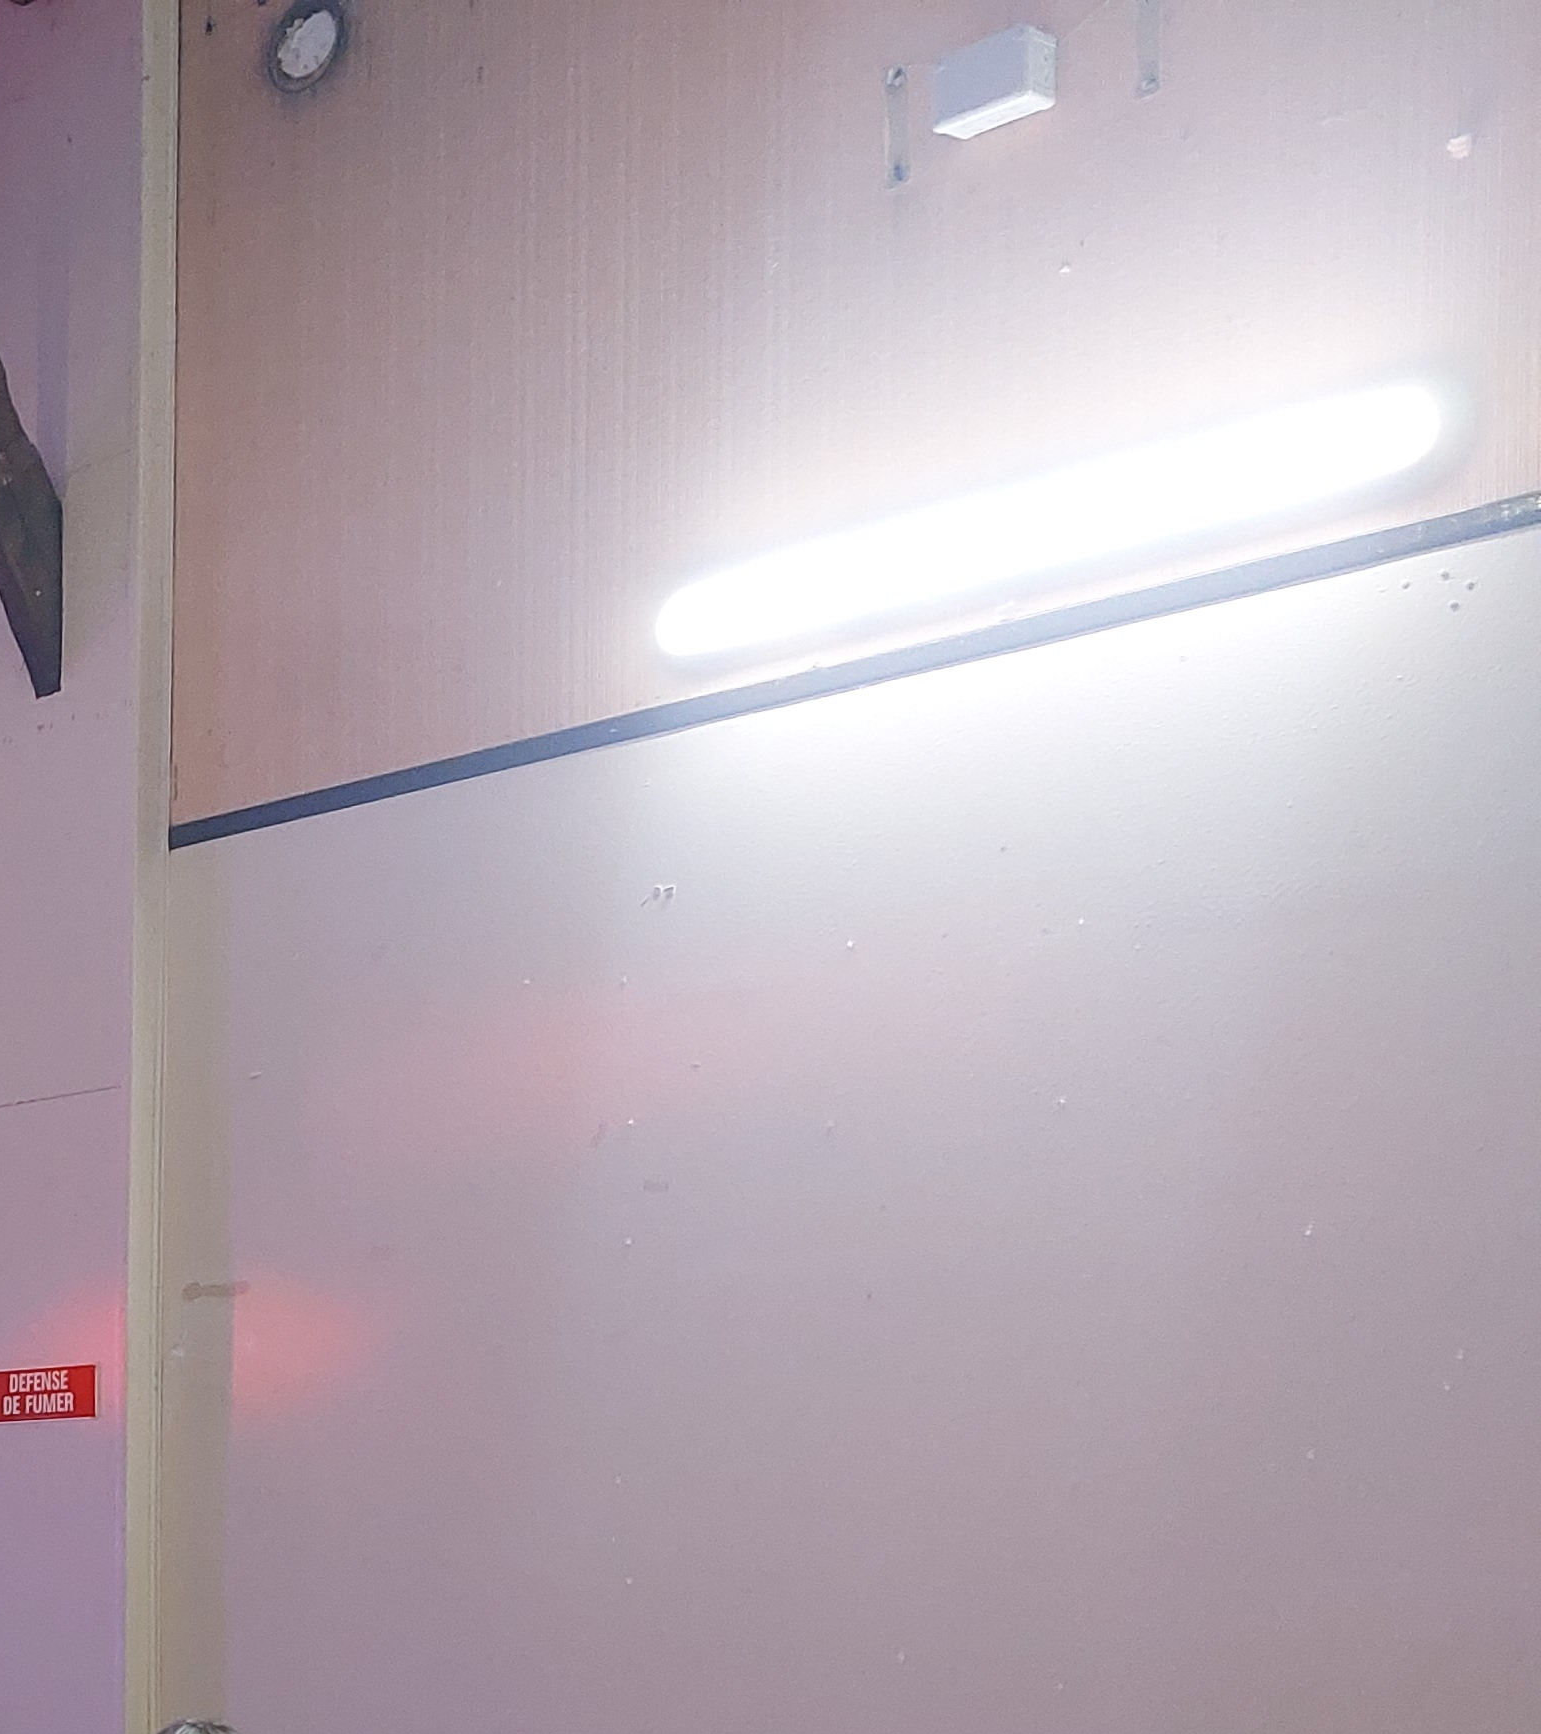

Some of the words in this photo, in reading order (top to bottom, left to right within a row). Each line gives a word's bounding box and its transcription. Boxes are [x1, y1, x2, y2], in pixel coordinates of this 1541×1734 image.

[9, 1370, 69, 1393] DEFENSE
[2, 1395, 21, 1415] DE
[25, 1391, 75, 1415] FUMER
